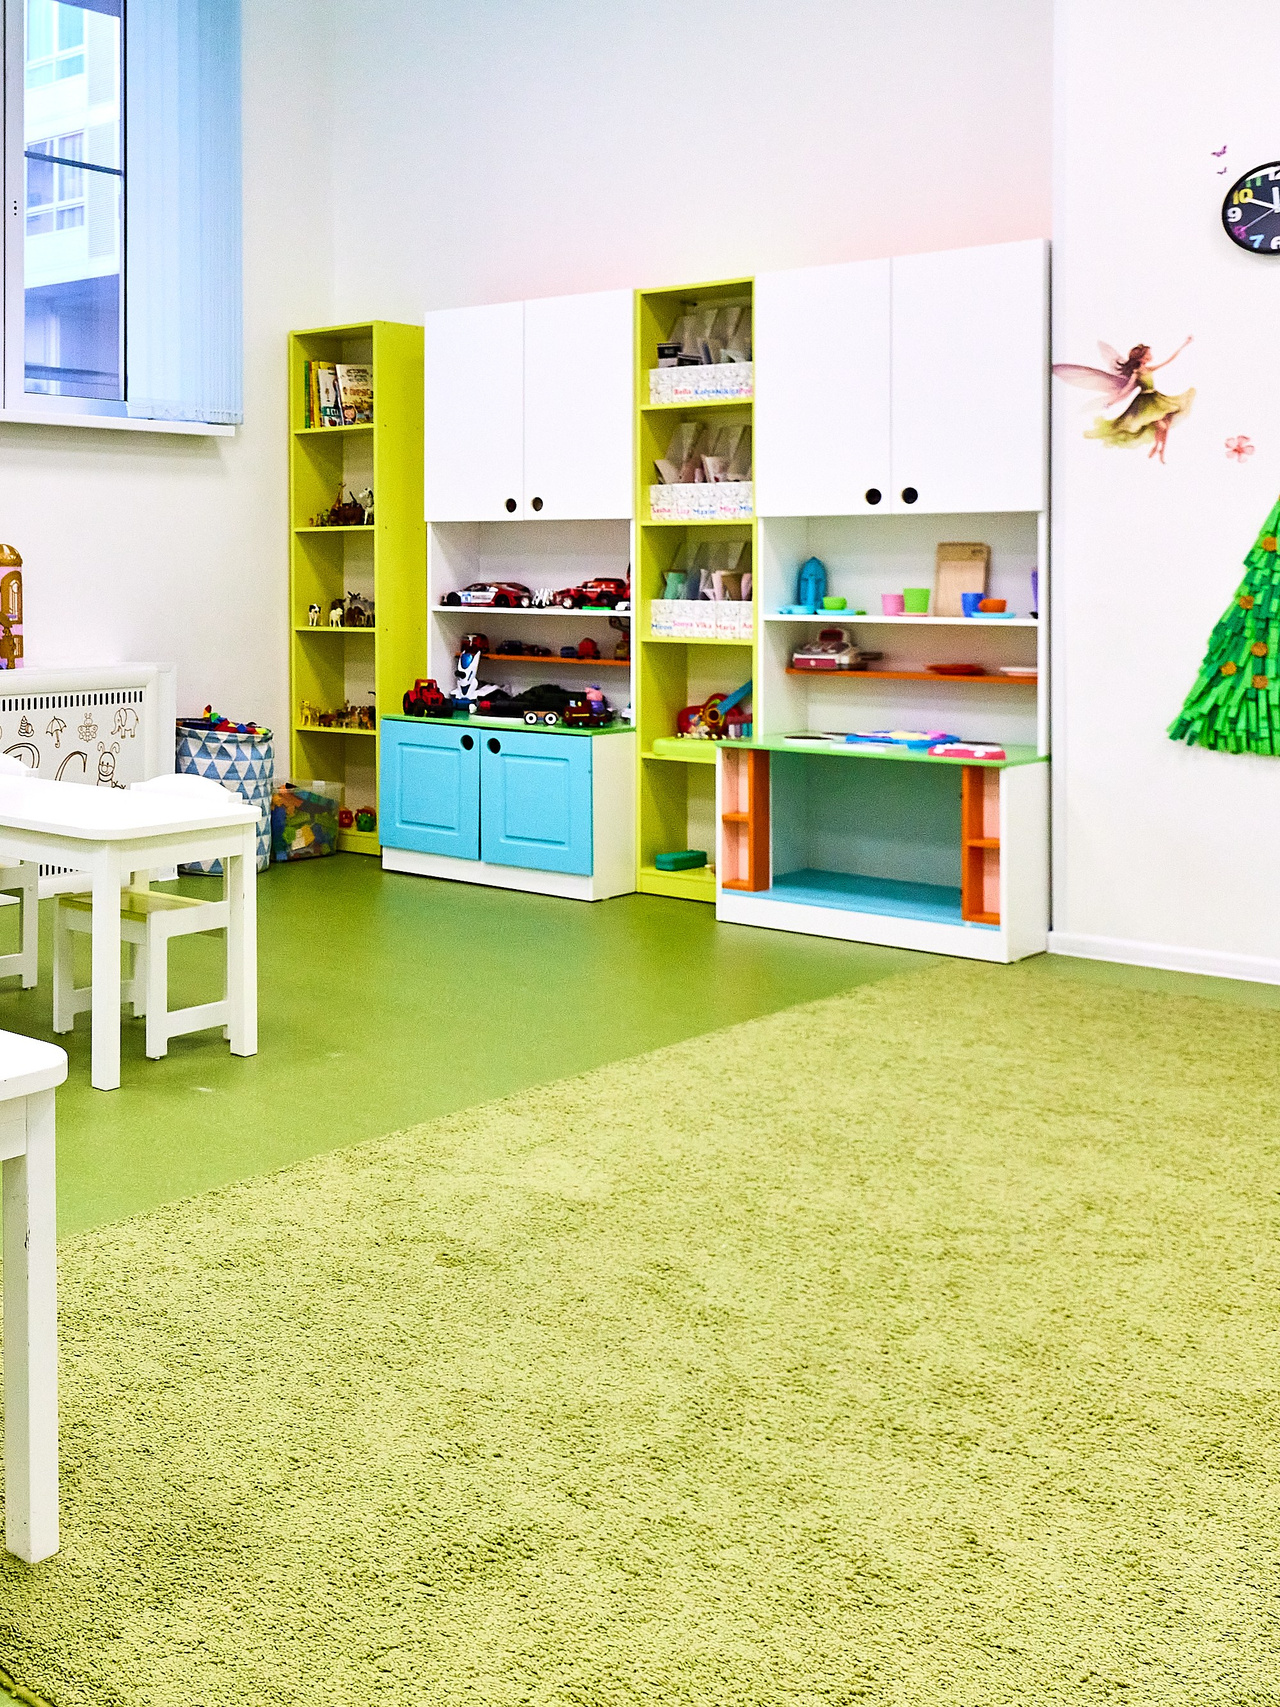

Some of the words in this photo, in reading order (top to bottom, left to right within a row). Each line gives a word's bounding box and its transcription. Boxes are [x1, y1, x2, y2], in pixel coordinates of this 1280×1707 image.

[1232, 188, 1254, 205] 10
[1227, 206, 1243, 223] 9
[1249, 234, 1265, 249] 7
